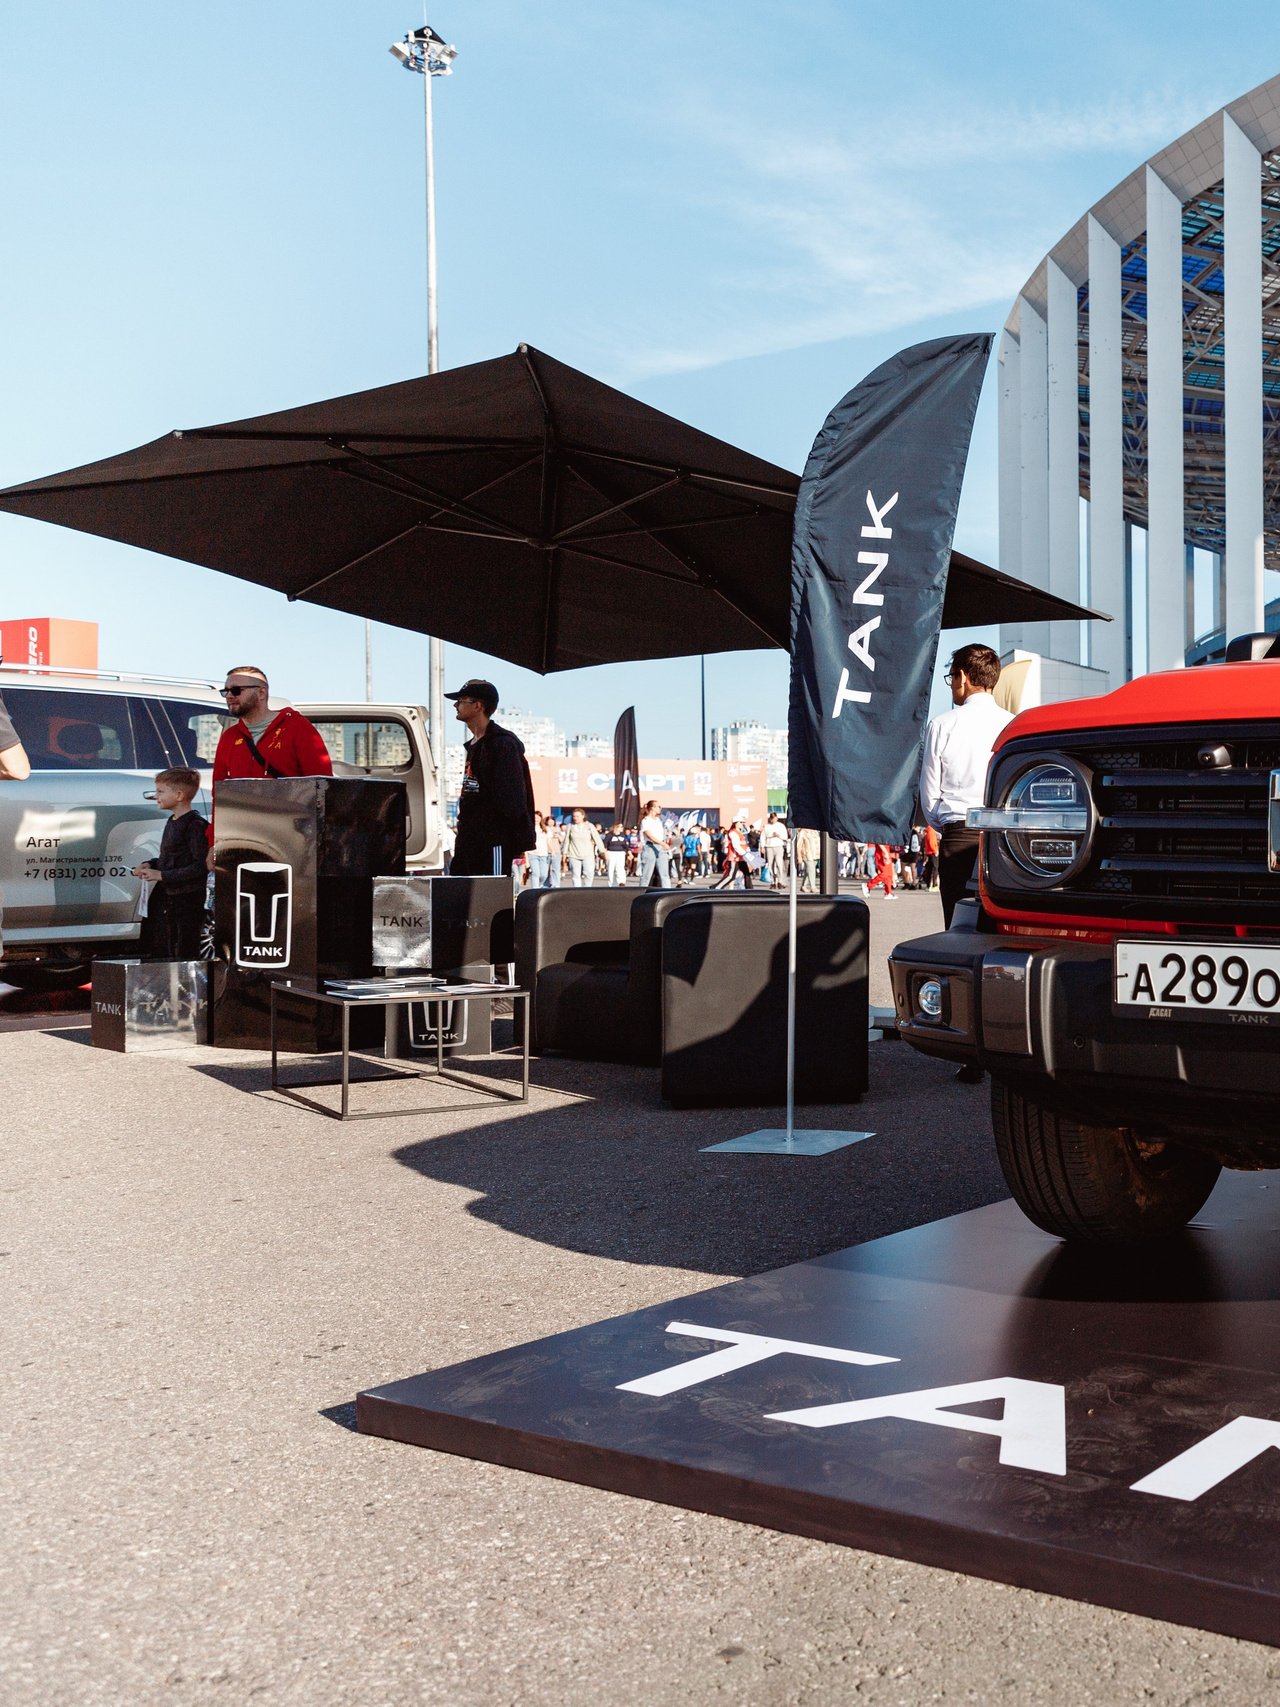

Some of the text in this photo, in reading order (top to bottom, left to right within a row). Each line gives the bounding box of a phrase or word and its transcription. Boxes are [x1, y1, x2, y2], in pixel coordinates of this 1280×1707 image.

[832, 490, 899, 718] TANK
[26, 836, 60, 848] Агат
[26, 857, 37, 865] ул.
[24, 868, 40, 879] +7
[44, 868, 76, 880] (831)
[80, 867, 105, 878] 200
[109, 867, 126, 877] 02
[380, 915, 423, 928] TANK
[243, 946, 283, 957] TANK
[95, 1001, 122, 1016] TANK
[1228, 1013, 1269, 1025] TANK
[419, 1032, 459, 1041] TANK
